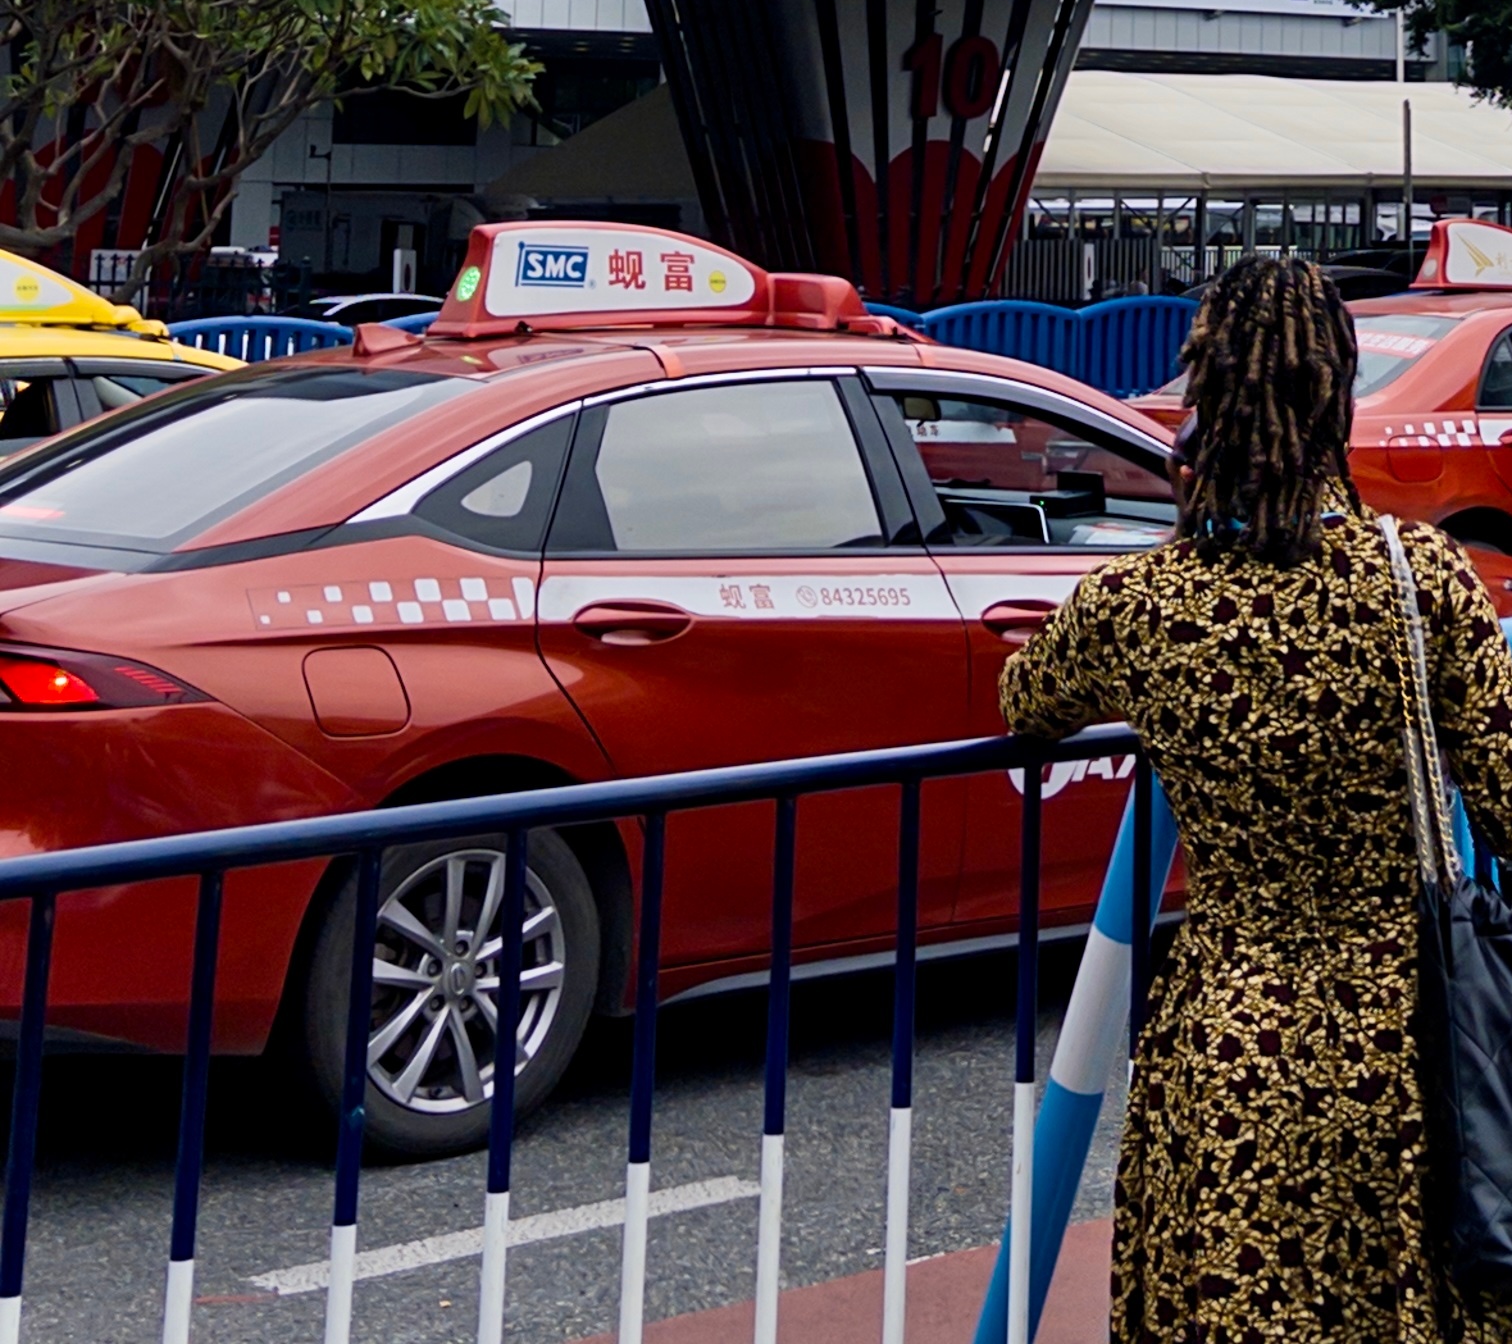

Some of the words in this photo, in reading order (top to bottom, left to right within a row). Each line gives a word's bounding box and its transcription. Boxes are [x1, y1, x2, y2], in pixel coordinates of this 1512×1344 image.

[903, 32, 999, 119] 10
[527, 252, 584, 279] SMC
[608, 249, 695, 292] 蚬富
[719, 583, 775, 610] 蚬富
[820, 587, 911, 607] 84325695
